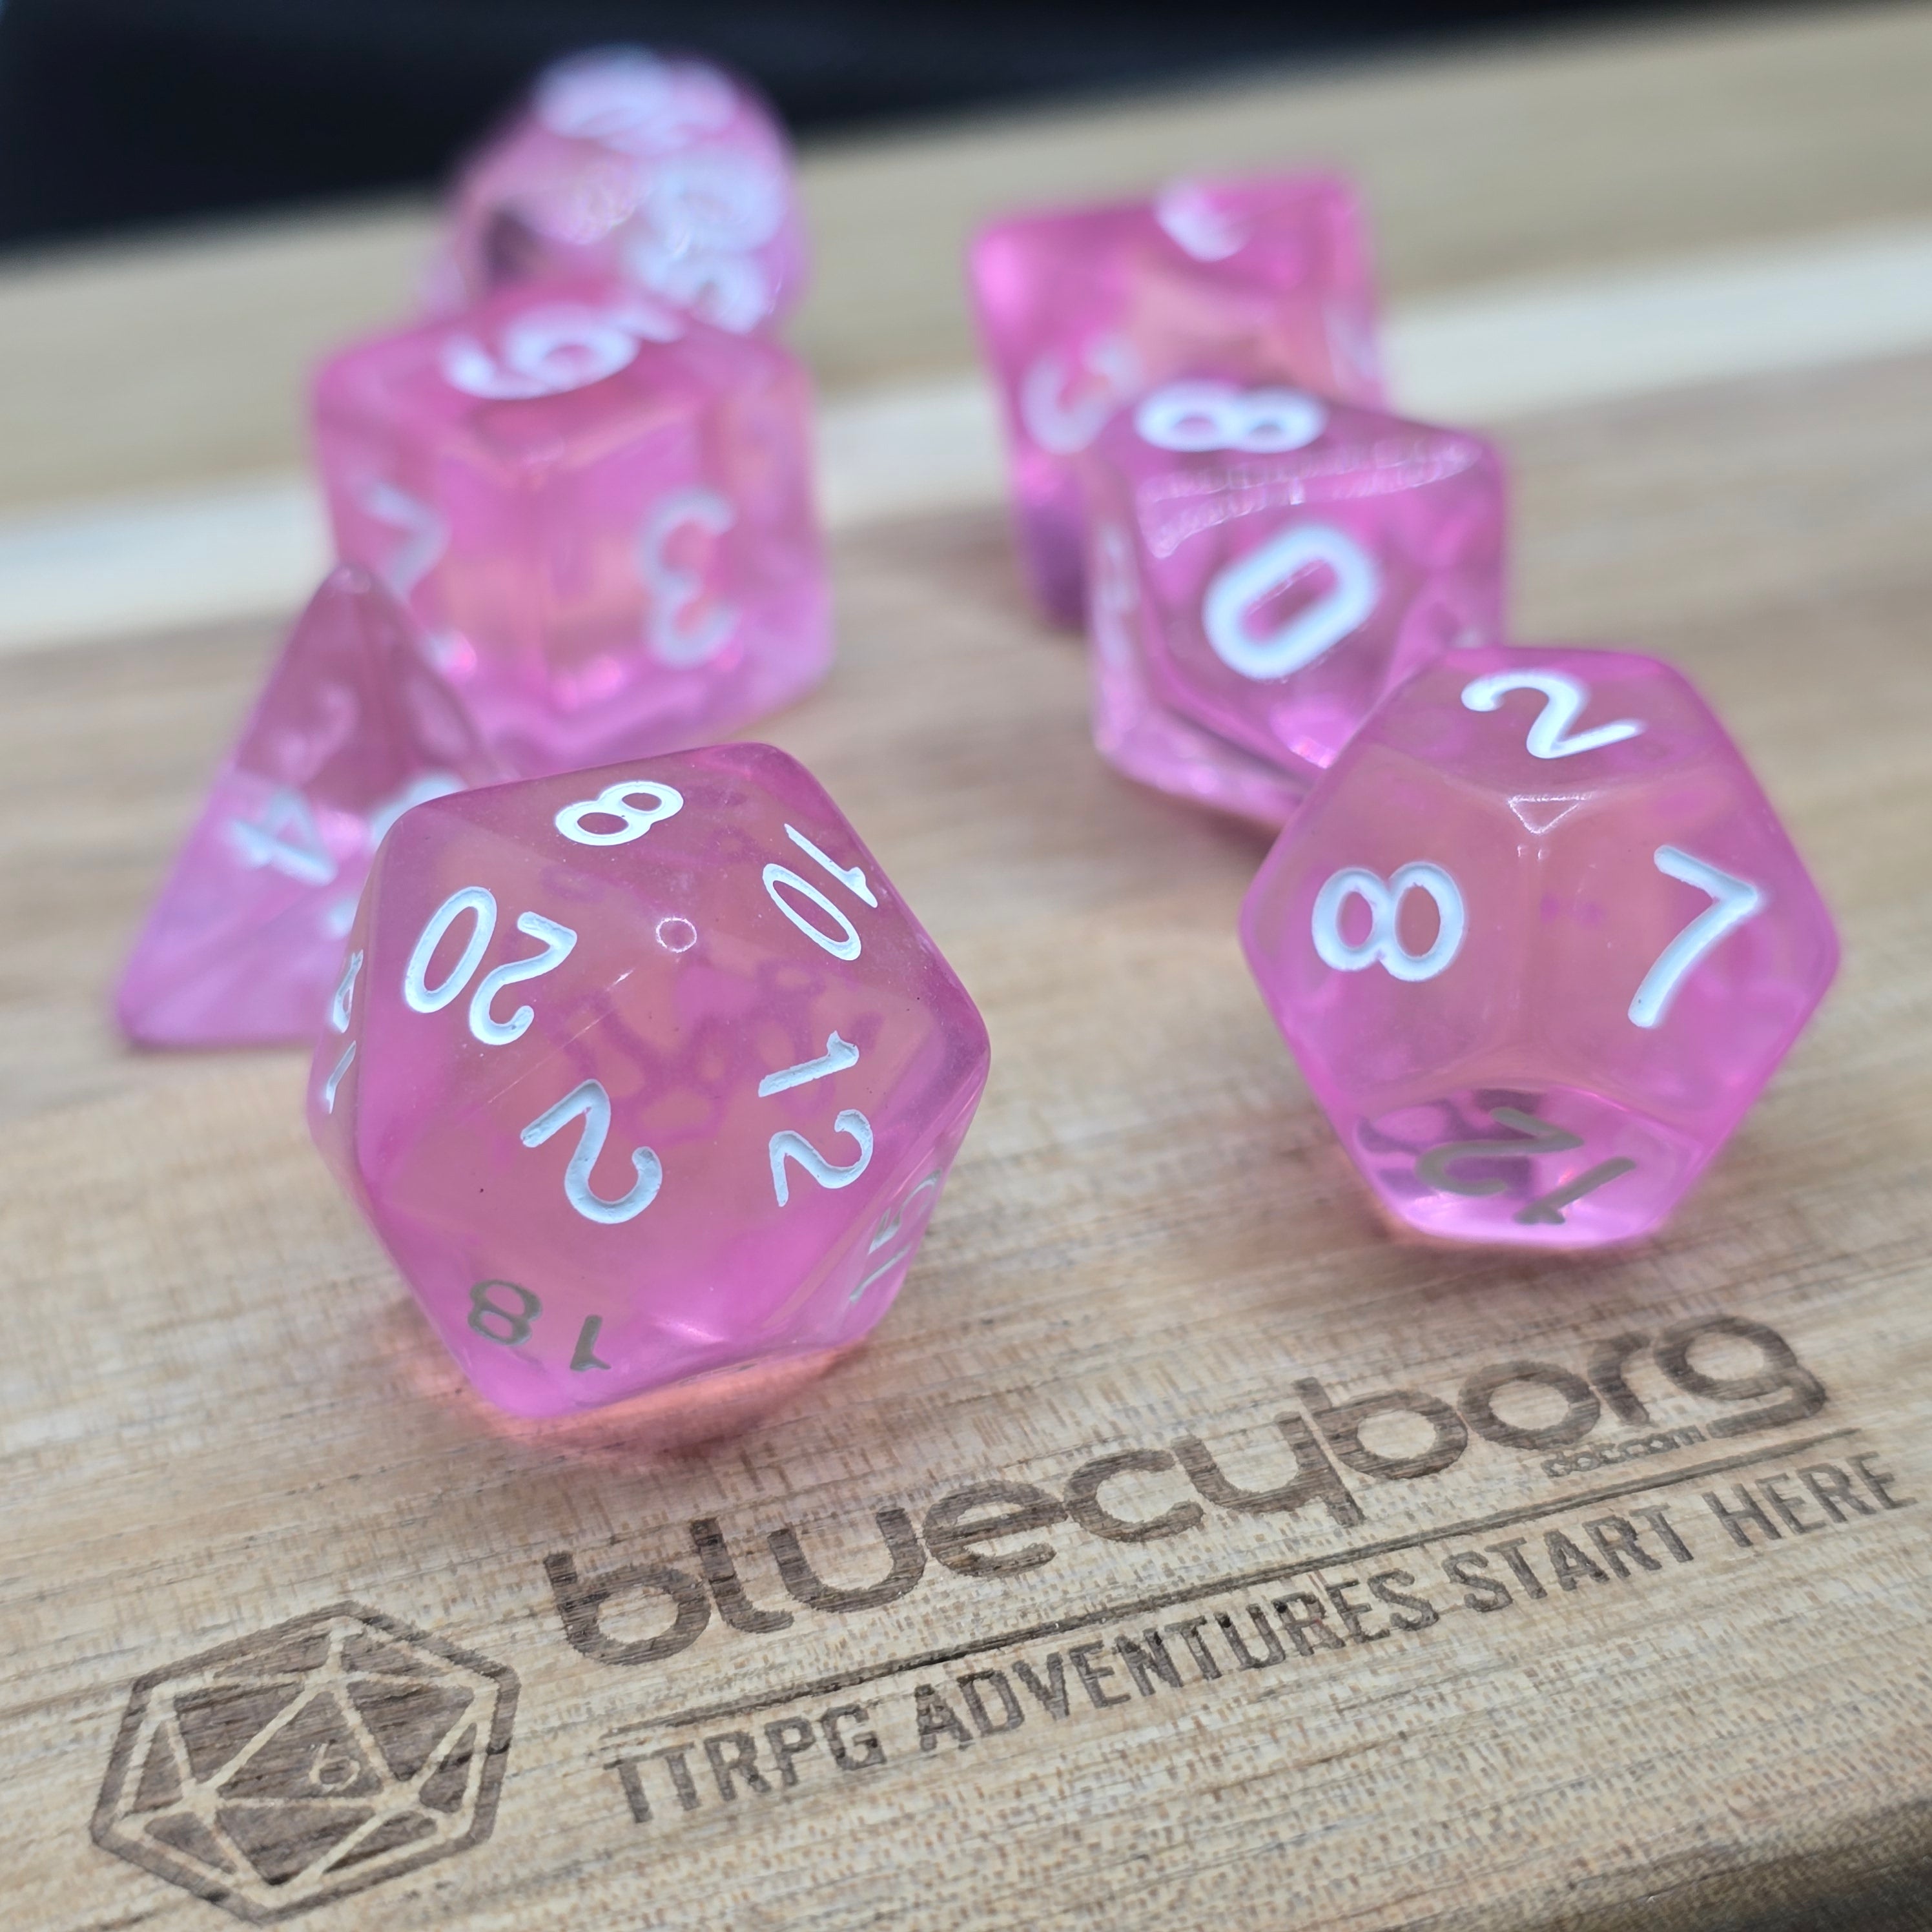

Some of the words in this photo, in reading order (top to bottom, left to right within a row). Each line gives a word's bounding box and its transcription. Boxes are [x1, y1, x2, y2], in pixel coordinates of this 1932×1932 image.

[1135, 378, 1327, 453] 8
[1202, 523, 1379, 680] 0
[1461, 670, 1645, 759] 2
[555, 780, 684, 847] 8
[762, 822, 879, 961] 10
[1311, 862, 1464, 981] 8
[1627, 845, 1764, 1028] 7
[405, 886, 578, 1045] 20
[520, 1078, 663, 1225] 2
[758, 1030, 874, 1208] 12
[1413, 1105, 1637, 1226] 12
[468, 1279, 612, 1373] 18
[542, 1314, 1829, 1667] bluecyborg
[604, 1703, 889, 1824] TTRPG
[914, 1568, 1439, 1752] ADVENTURES
[1440, 1503, 1694, 1614] START
[1701, 1452, 1918, 1549] HERE
